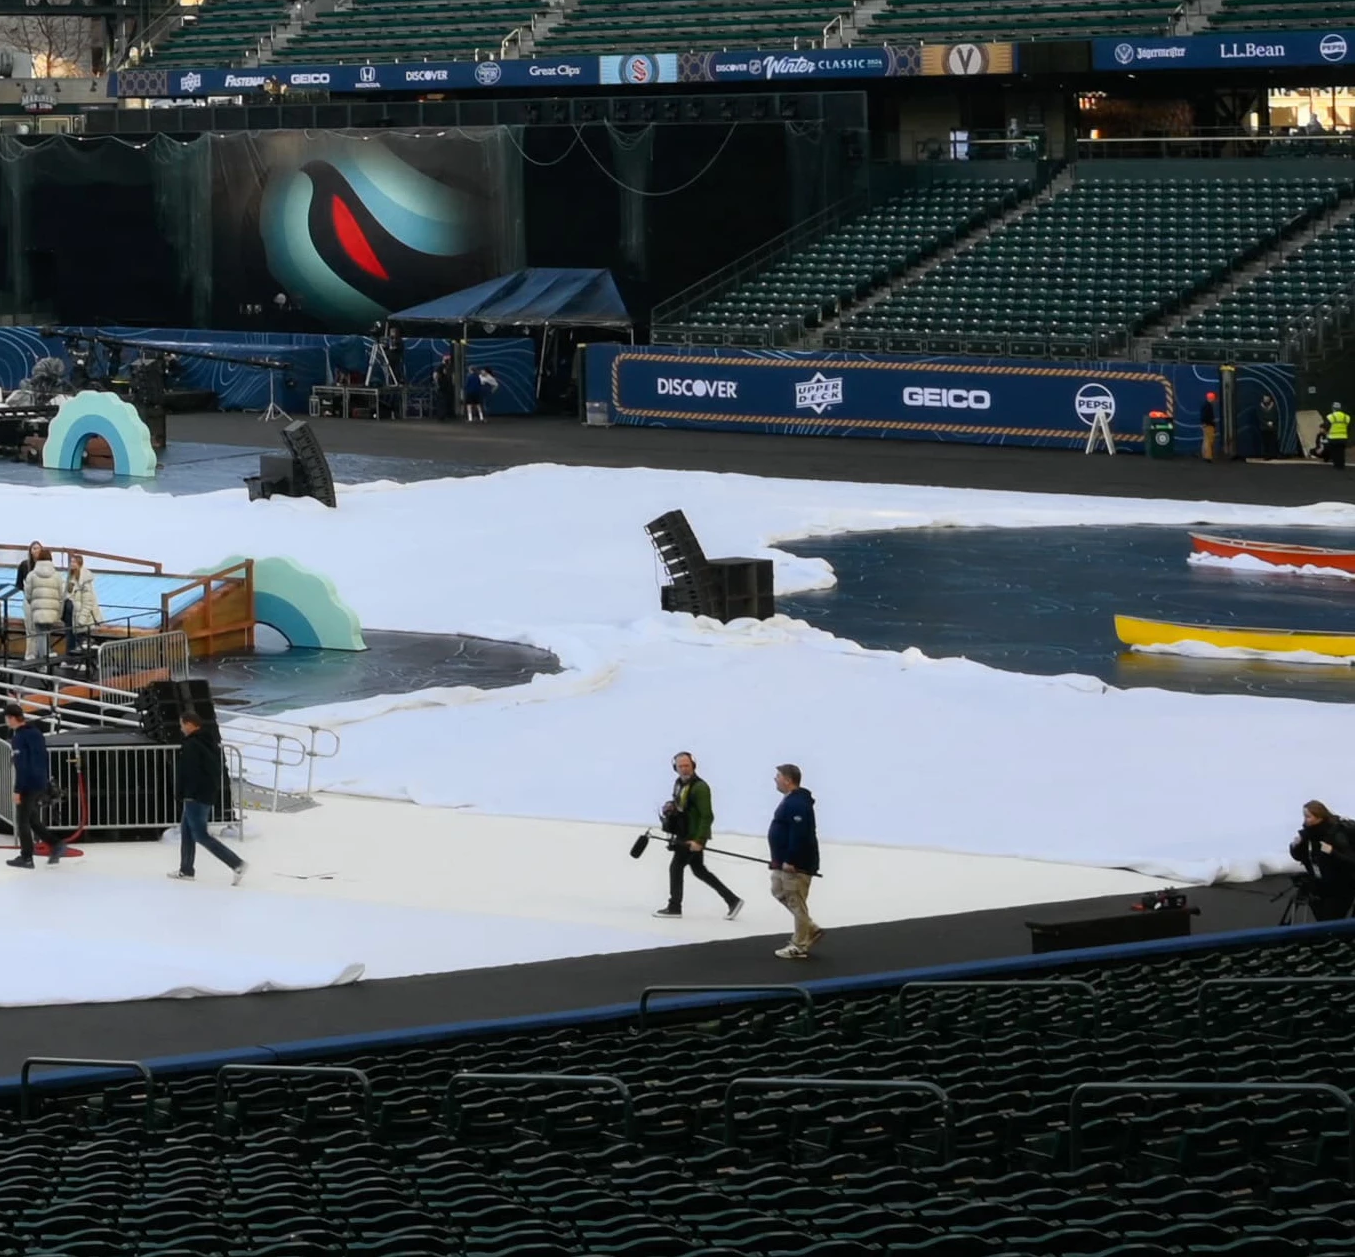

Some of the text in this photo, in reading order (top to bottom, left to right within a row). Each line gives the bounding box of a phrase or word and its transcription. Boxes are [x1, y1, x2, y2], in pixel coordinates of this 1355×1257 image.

[529, 65, 580, 77] Great Clips
[716, 63, 747, 72] DISCOVER
[763, 55, 816, 80] Winter
[819, 59, 864, 69] CLASSIC
[291, 73, 330, 84] GEICO
[406, 70, 448, 82] DISCOVER
[658, 378, 737, 398] DISCOVER
[798, 383, 839, 395] UPPER
[798, 392, 839, 403] DECK
[903, 387, 990, 409] GEICO
[1079, 400, 1113, 410] PEPSI
